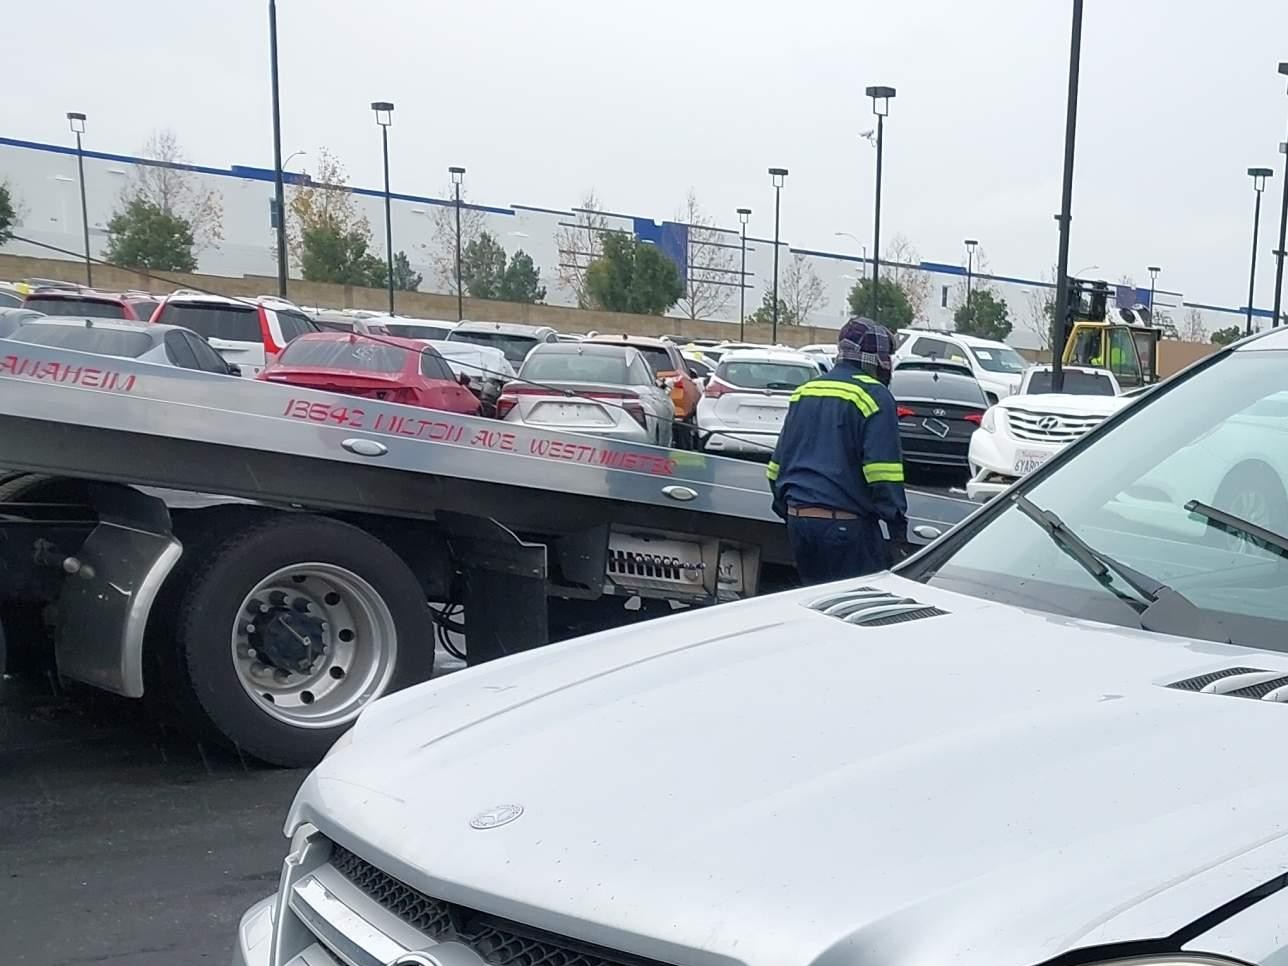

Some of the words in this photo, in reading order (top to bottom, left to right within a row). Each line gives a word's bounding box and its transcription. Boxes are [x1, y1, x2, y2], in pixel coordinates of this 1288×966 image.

[0, 355, 136, 392] ANAHEIM
[284, 399, 365, 427] 13642
[471, 429, 517, 452] AVE.
[530, 438, 679, 476] WESTMINSTER
